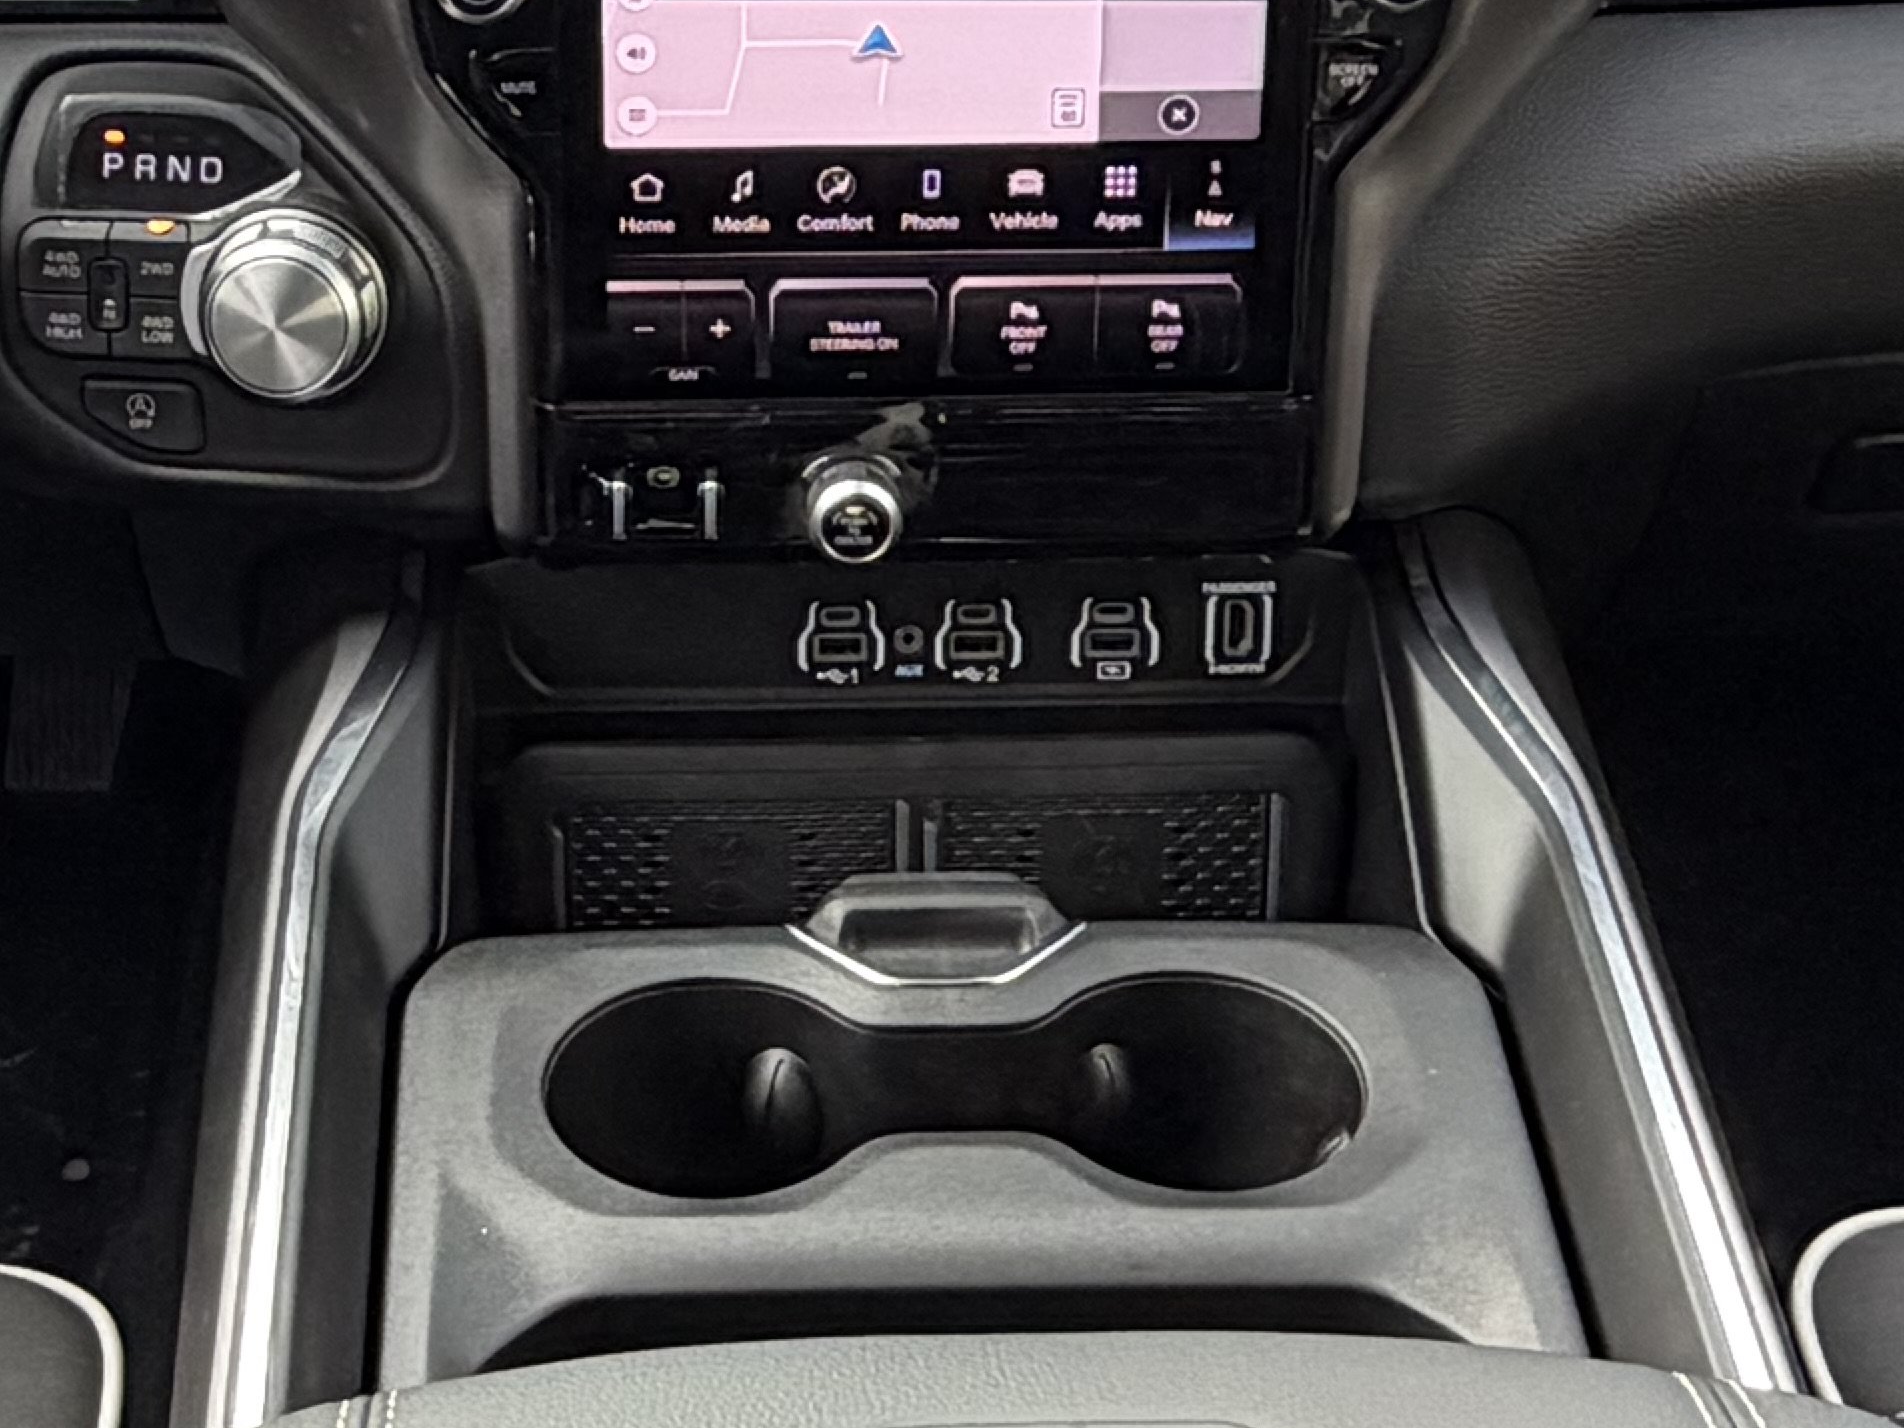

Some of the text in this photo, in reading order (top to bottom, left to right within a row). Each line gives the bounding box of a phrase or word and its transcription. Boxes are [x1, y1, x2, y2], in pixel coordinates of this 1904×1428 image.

[102, 152, 224, 183] P R N D
[618, 215, 676, 234] Home
[712, 214, 772, 234] Media
[796, 212, 875, 233] Comfort
[900, 212, 961, 231] Phone
[989, 211, 1060, 230] Vehicle
[1093, 210, 1144, 232] Apps
[1194, 208, 1235, 228] Nav
[141, 329, 175, 344] LOW
